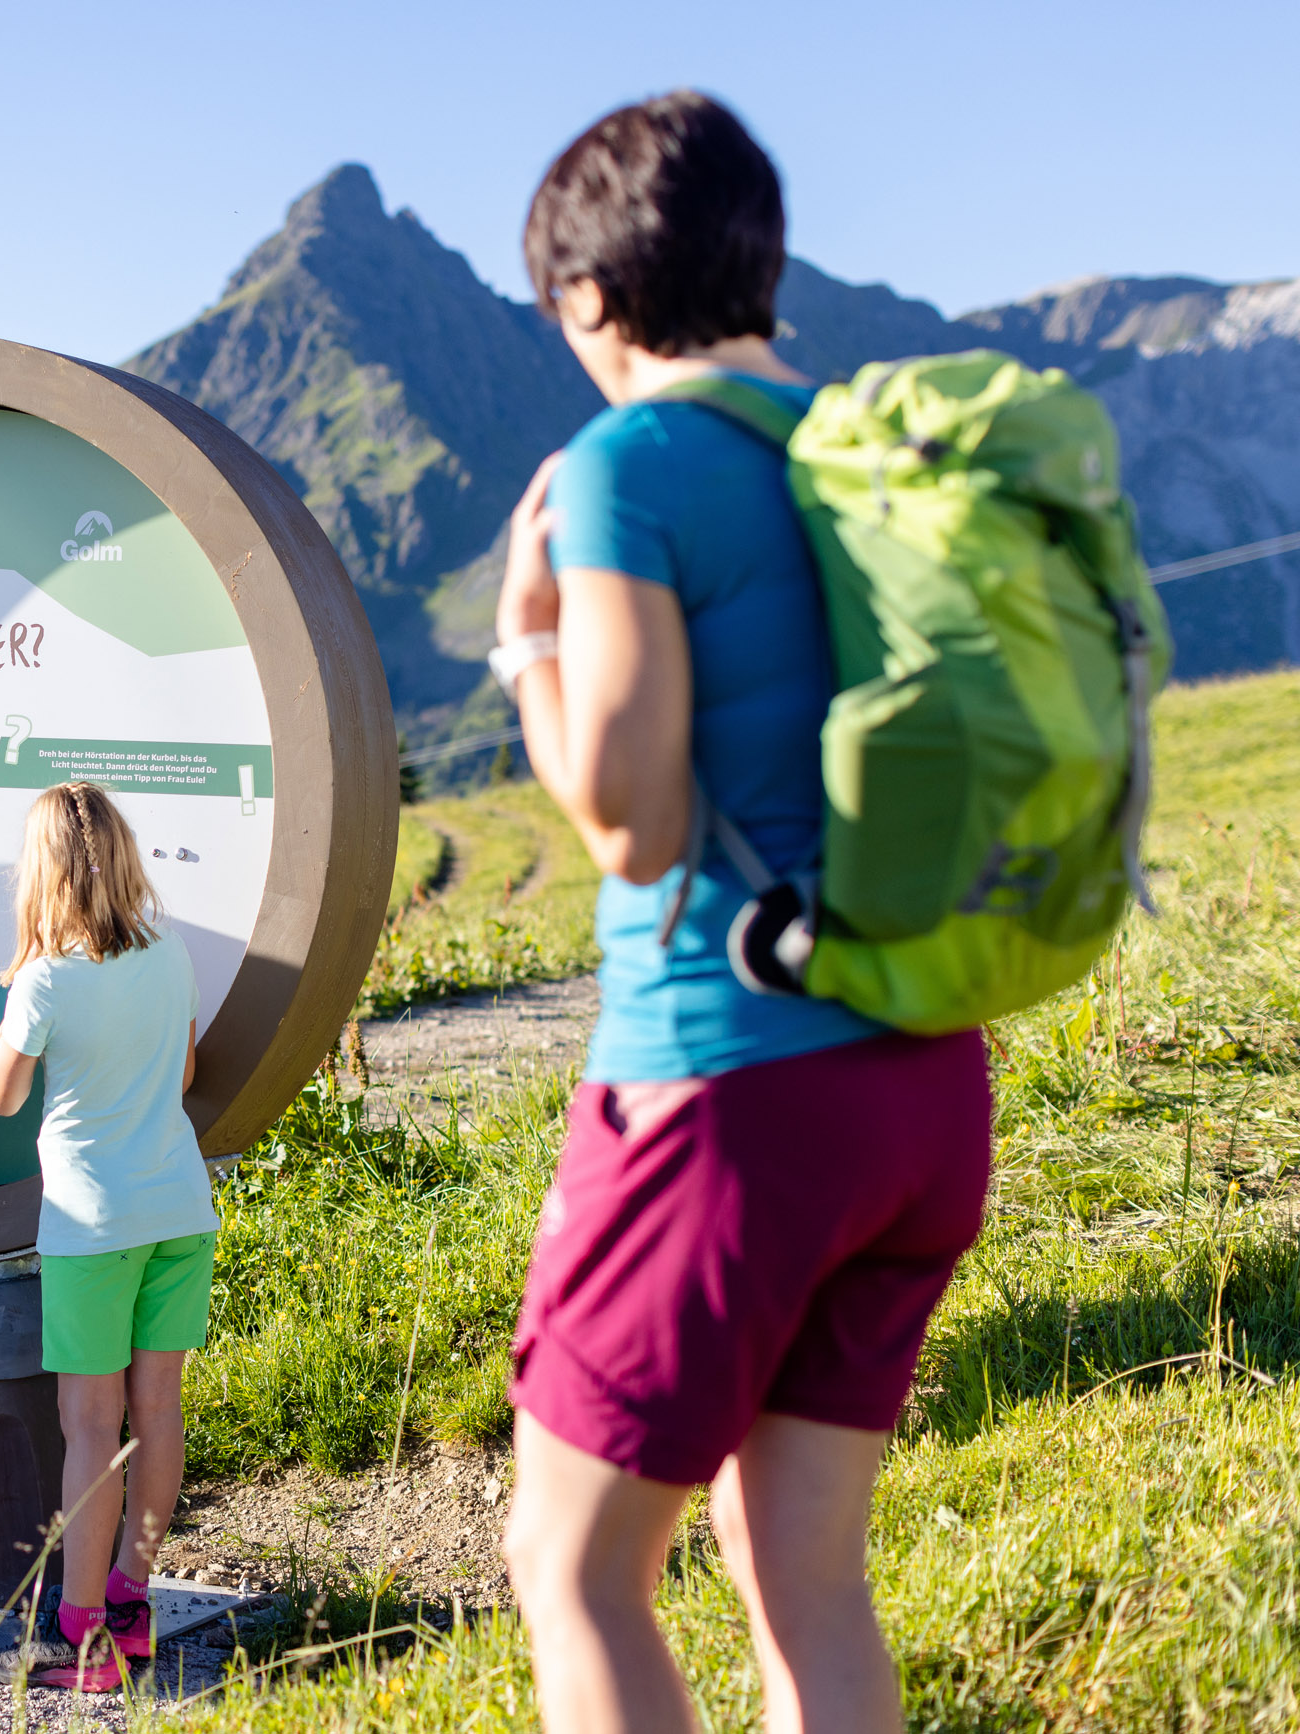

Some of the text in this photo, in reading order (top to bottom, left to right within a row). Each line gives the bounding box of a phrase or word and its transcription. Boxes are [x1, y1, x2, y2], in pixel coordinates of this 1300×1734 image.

[60, 539, 122, 561] Golm
[38, 750, 57, 758] Dreh
[58, 750, 70, 759] bei
[70, 751, 84, 759] der
[84, 751, 125, 760] Hörstation
[137, 753, 150, 761] der
[151, 753, 179, 763] Kurbel,
[180, 754, 192, 763] bis
[193, 755, 207, 763] das
[51, 761, 217, 775] Licht leuchtet. Dann drück den Knopf und Du
[70, 771, 110, 780] bekommst
[110, 773, 133, 781] einen
[134, 773, 150, 784] Tipp
[167, 775, 185, 783] Frau
[186, 775, 206, 784] Eule!
